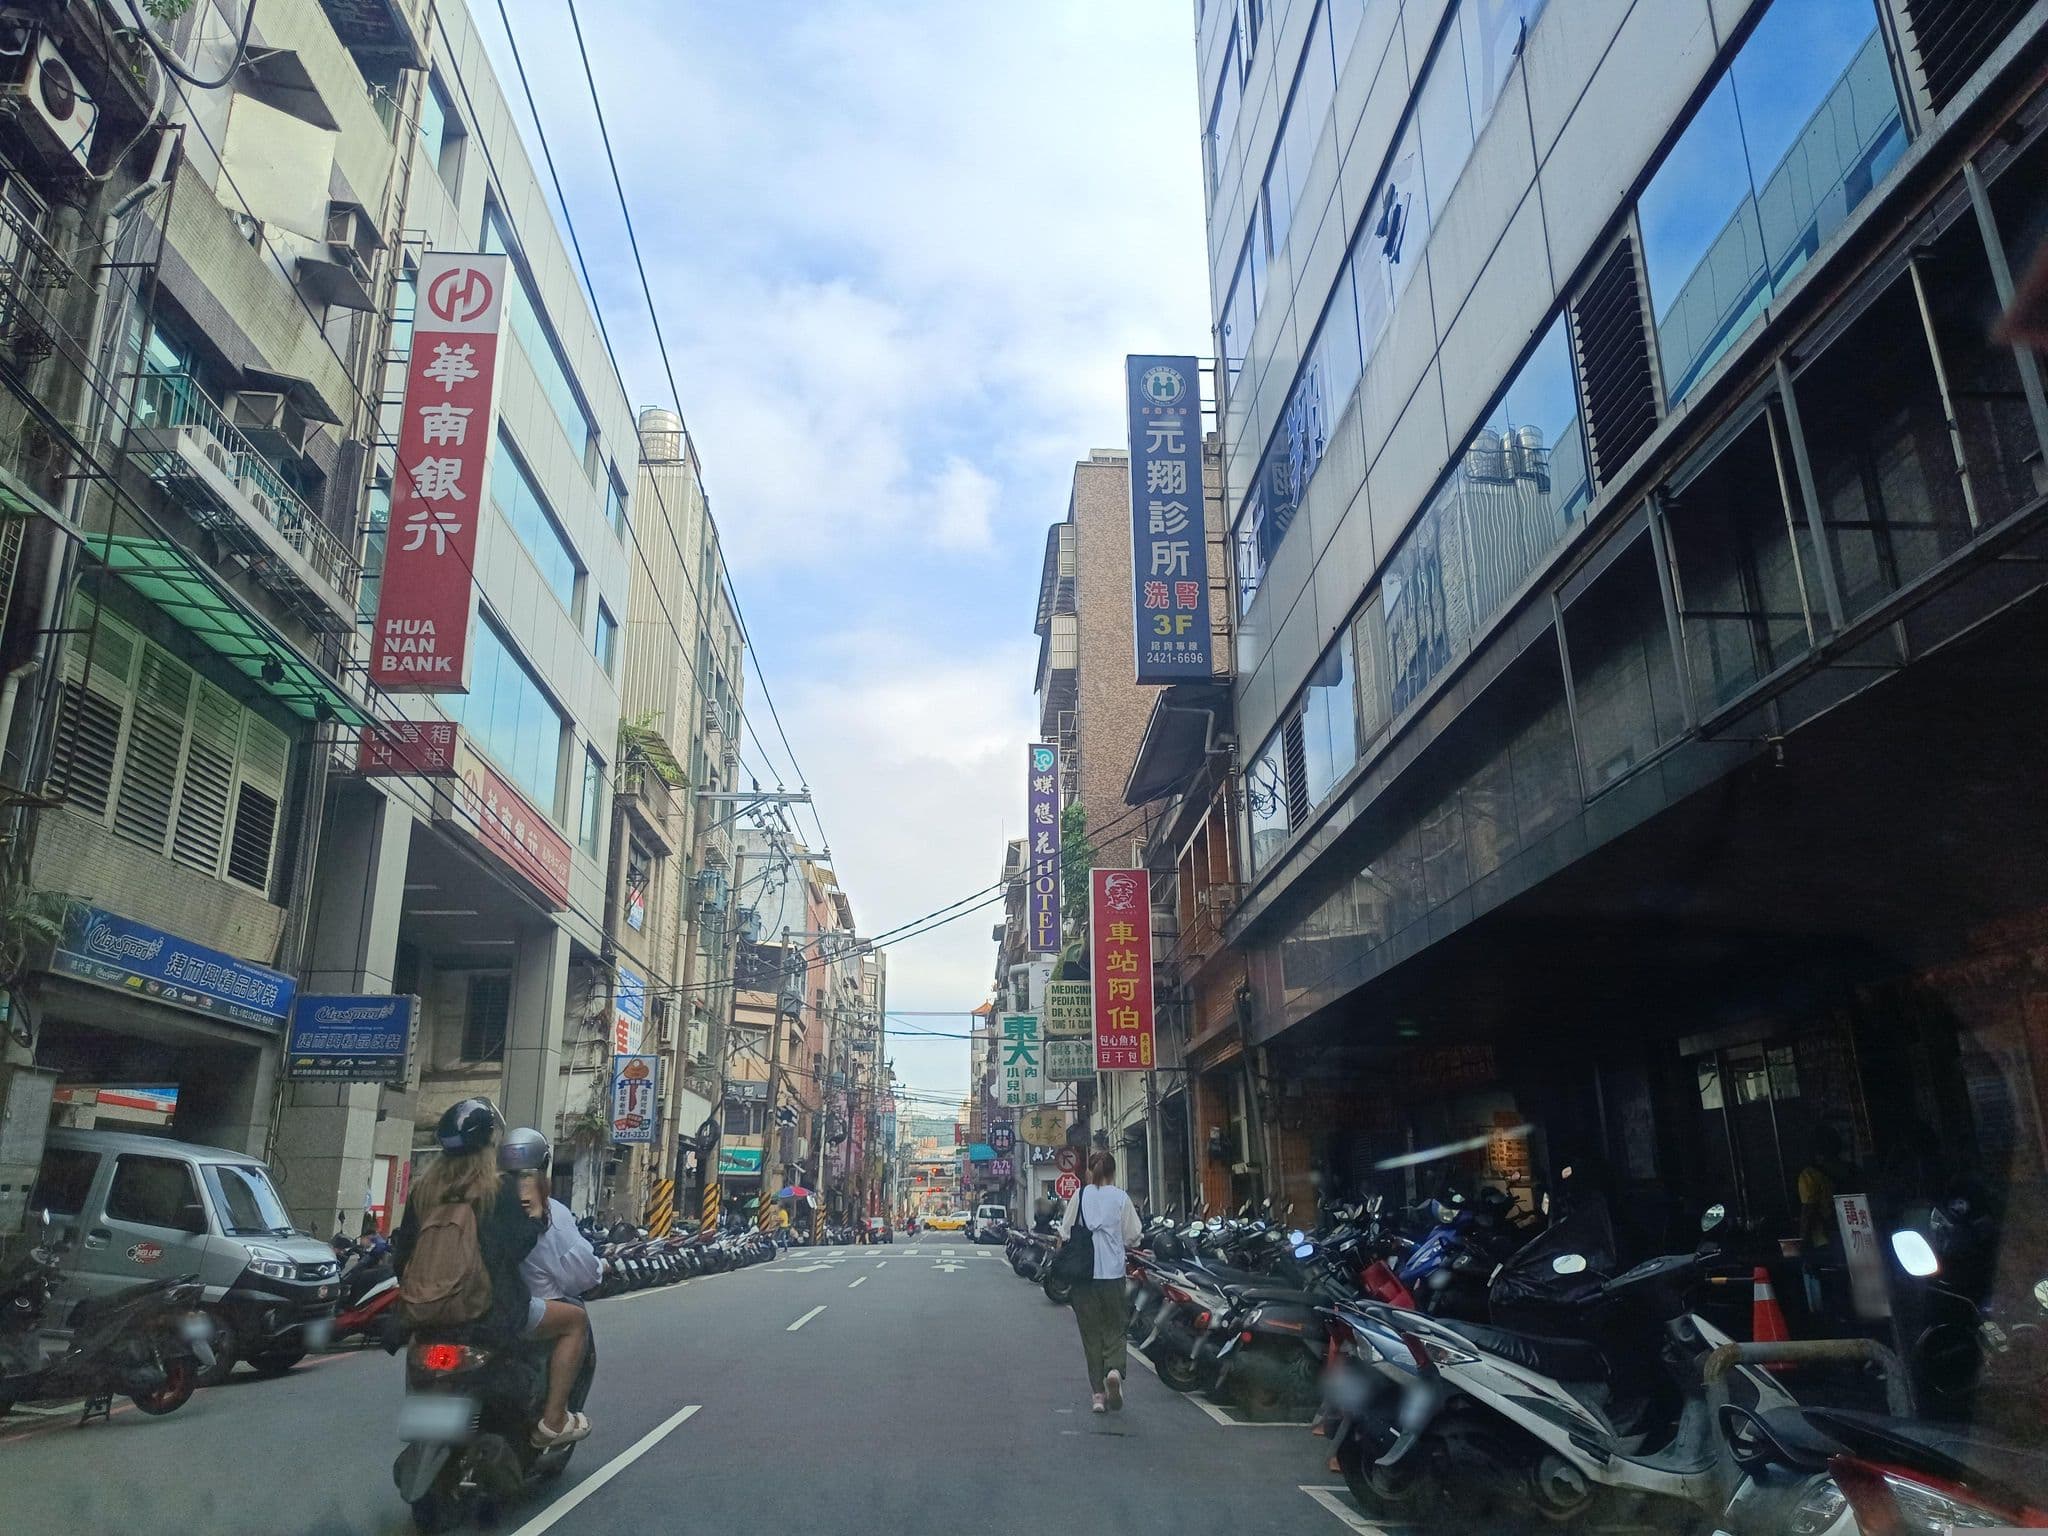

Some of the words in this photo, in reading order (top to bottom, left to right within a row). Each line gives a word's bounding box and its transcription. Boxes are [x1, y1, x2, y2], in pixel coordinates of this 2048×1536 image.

[402, 341, 478, 556] 華南銀行
[1146, 421, 1190, 576] 元翔診所
[1145, 581, 1199, 609] 洗腎
[386, 619, 436, 635] HUA
[1153, 614, 1193, 635] 3F
[383, 637, 436, 652] NAN
[381, 655, 452, 672] BANK
[1147, 652, 1203, 664] 2421-6696
[1035, 859, 1054, 947] HOTEL
[1105, 921, 1140, 1030] 車站阿伯
[1051, 985, 1091, 994] MEDICIN
[1051, 997, 1091, 1005] PEDIATRI
[1003, 1016, 1039, 1066] 東大
[1100, 1035, 1138, 1046] 包心魚丸
[1102, 1051, 1138, 1063] 豆干包
[1007, 1067, 1020, 1104] 小兒科
[1024, 1067, 1038, 1104] 內科
[1031, 1115, 1062, 1130] 東大
[1058, 1177, 1077, 1197] 停
